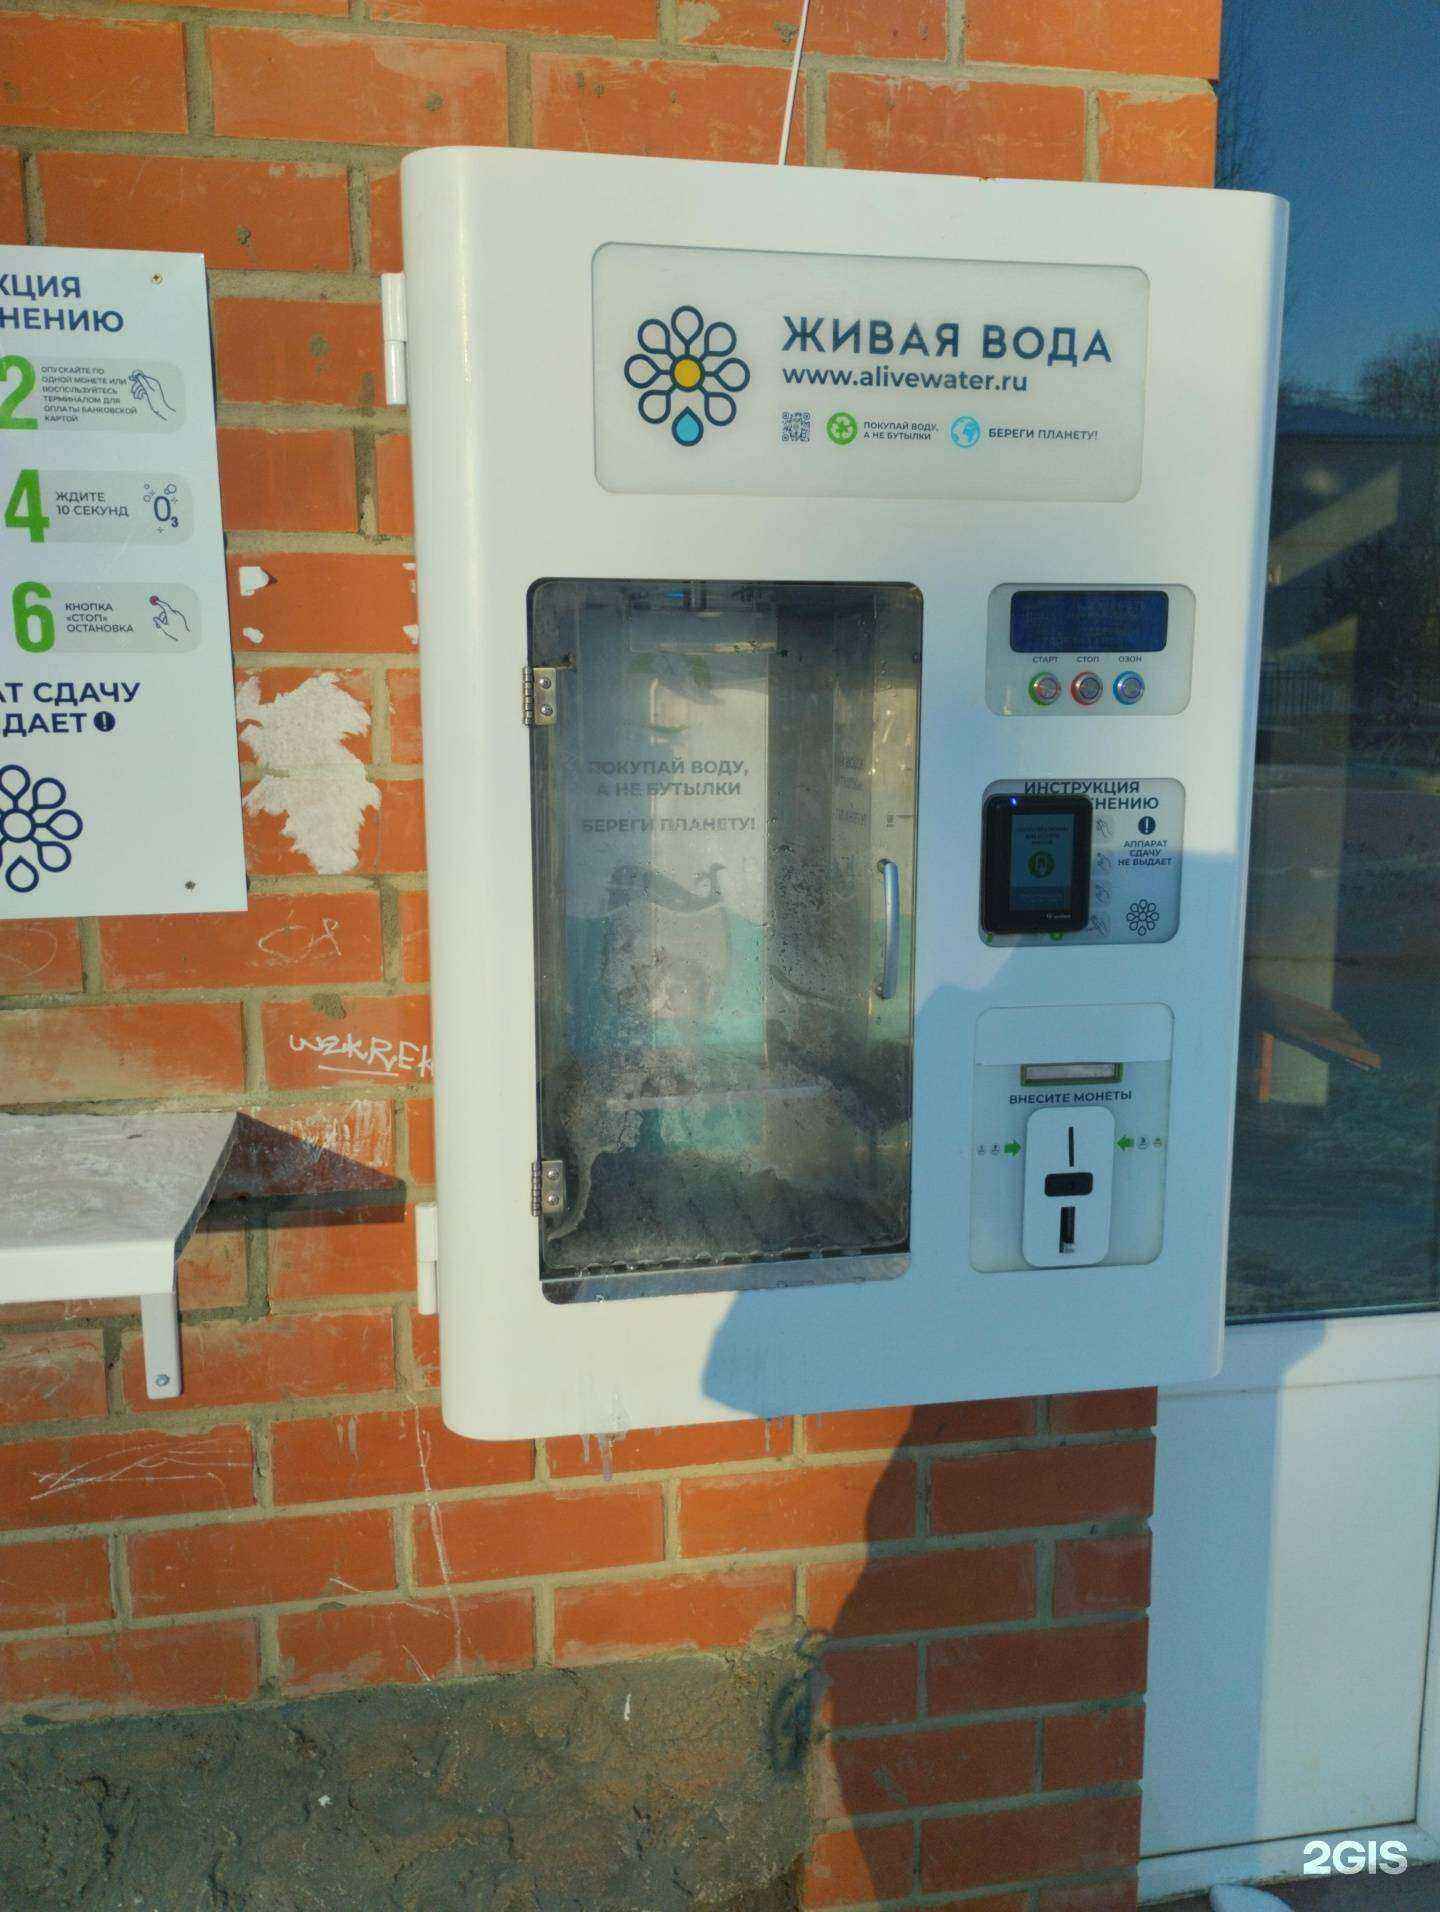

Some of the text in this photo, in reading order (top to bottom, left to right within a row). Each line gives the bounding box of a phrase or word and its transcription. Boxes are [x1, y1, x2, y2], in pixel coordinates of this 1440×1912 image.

[0, 306, 124, 332] НЕНИЮ
[781, 315, 1112, 368] ЖИВАЯ ВОДА
[41, 366, 91, 375] ОПУСКАЙТЕ
[782, 365, 1028, 392] www.alivewater.ru
[0, 355, 38, 430] 2
[44, 415, 79, 423] КАРТОЙ
[863, 420, 909, 431] ПОКУПАЙ
[863, 431, 932, 441] А НЕ БУТЫЛКИ
[988, 428, 1099, 441] БЕРЕГИ ПЛАНЕТУ!
[55, 490, 106, 503] ЖДИТЕ
[4, 469, 50, 543] 4
[57, 505, 130, 517] 10 СЕКУНД
[65, 602, 114, 612] КНОПКА
[12, 581, 56, 653] 6
[66, 624, 135, 633] ОСТАНОВКА
[1032, 655, 1142, 664] СТАРТ СТОП ОЗОН
[33, 682, 141, 706] СДАЧУ
[2, 712, 87, 738] ДАЕТ
[587, 757, 750, 777] ПОКУПАЙ ВОДУ,
[646, 782, 741, 796] БУТЫЛКИ
[1024, 781, 1140, 795] ИНСТРУКЦИЯ
[1090, 797, 1159, 810] НЕНИЮ
[582, 817, 756, 832] БЕРЕГИ ПЛАНЕТУ!
[1123, 840, 1168, 848] АППАРАТ
[1129, 849, 1161, 857] СДАЧУ
[1117, 857, 1172, 866] НЕ ВЫДАЕТ
[1008, 1090, 1132, 1105] ВНЕСИТЕ МОНЕТЫ
